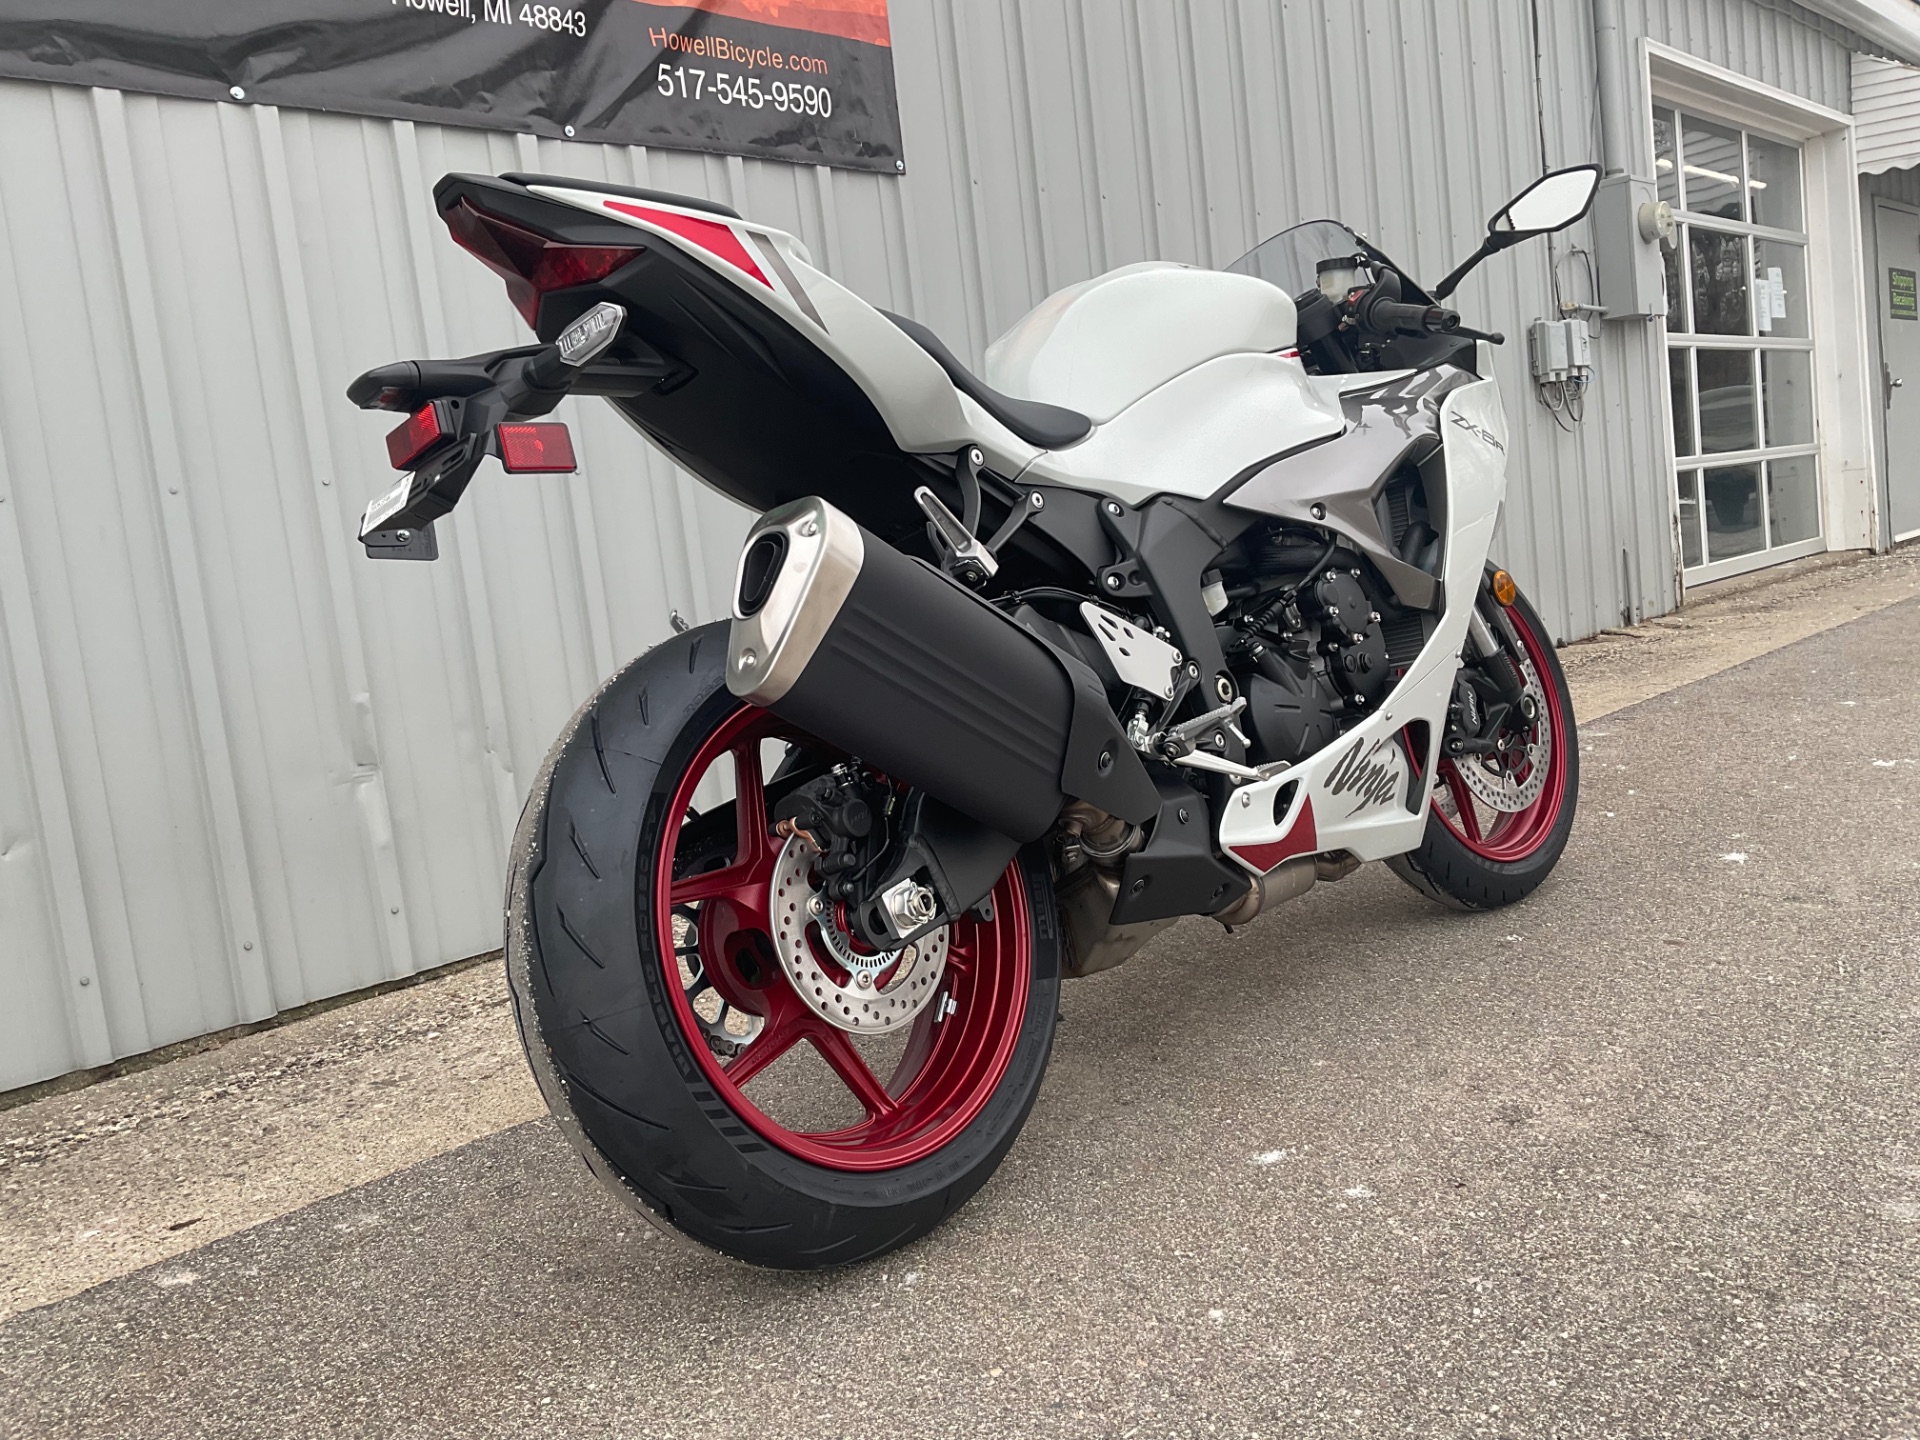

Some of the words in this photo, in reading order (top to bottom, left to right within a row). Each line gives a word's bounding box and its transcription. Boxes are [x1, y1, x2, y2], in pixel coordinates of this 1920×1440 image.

[391, 0, 476, 23] owell,
[484, 0, 512, 25] MI
[518, 3, 587, 38] 48843
[648, 26, 828, 75] HowellBicycle.com
[657, 64, 832, 118] 517-545-9590
[1451, 410, 1505, 456] ZX-6R
[1323, 736, 1399, 818] Ninja
